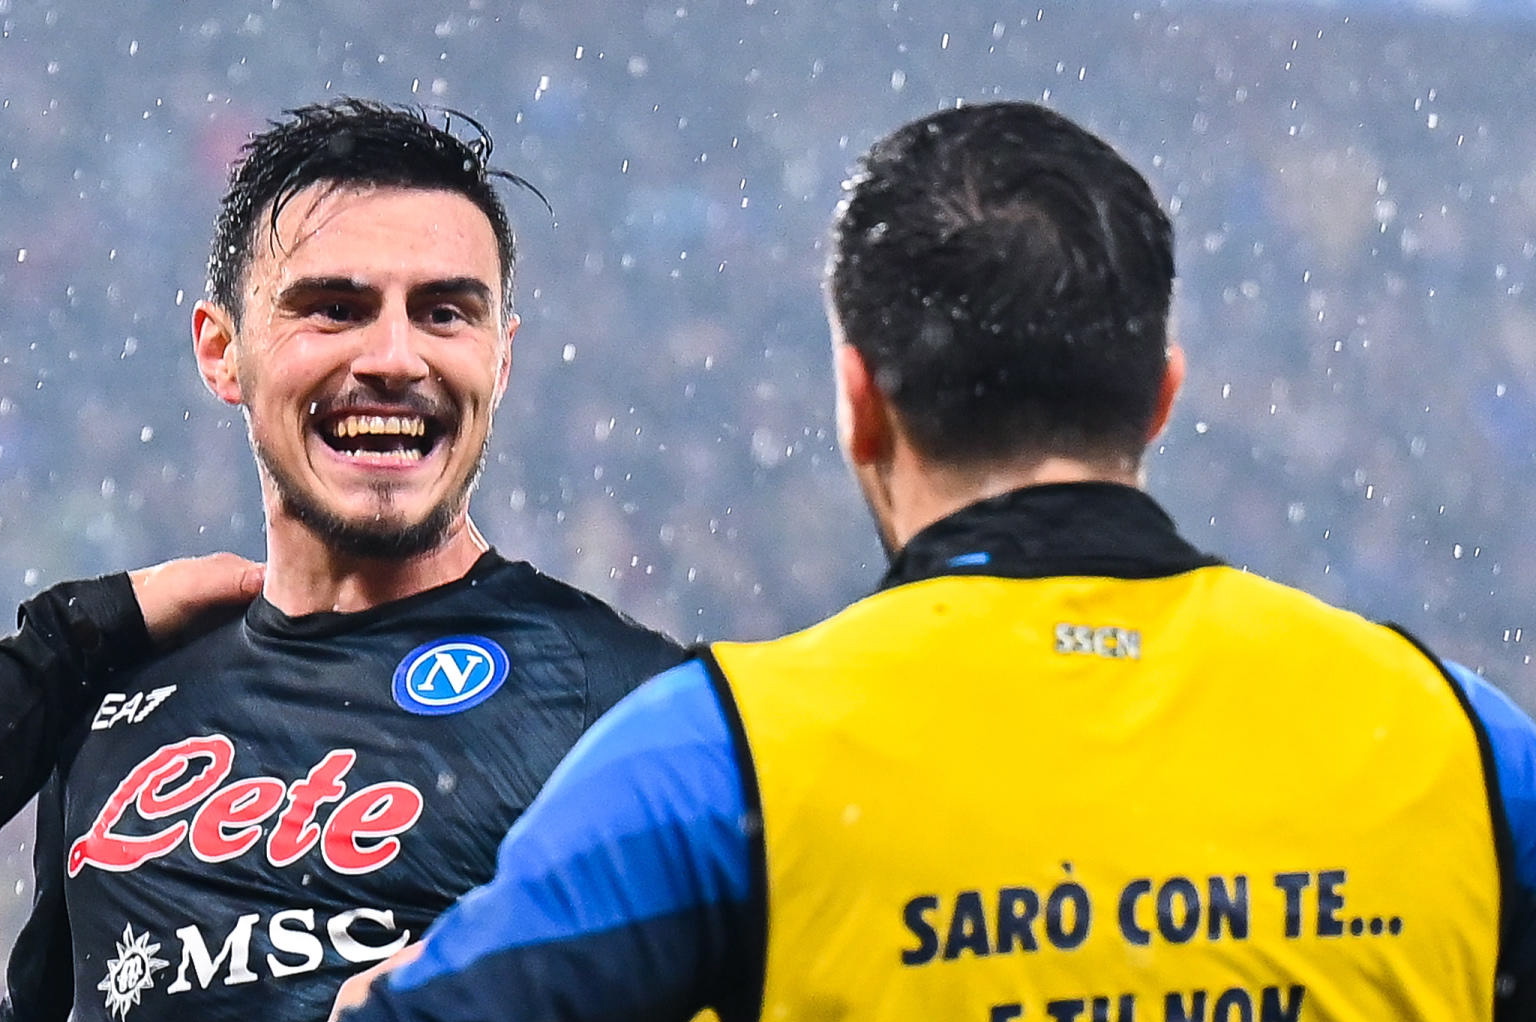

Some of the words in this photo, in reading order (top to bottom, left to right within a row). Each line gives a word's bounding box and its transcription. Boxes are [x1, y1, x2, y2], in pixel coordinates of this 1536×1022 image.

[91, 685, 177, 730] EA7
[417, 653, 483, 694] N
[68, 734, 424, 878] Lete
[168, 908, 410, 995] MSC
[900, 862, 1091, 967] SARÒ
[1117, 875, 1249, 947] CON
[1274, 869, 1404, 938] TE...
